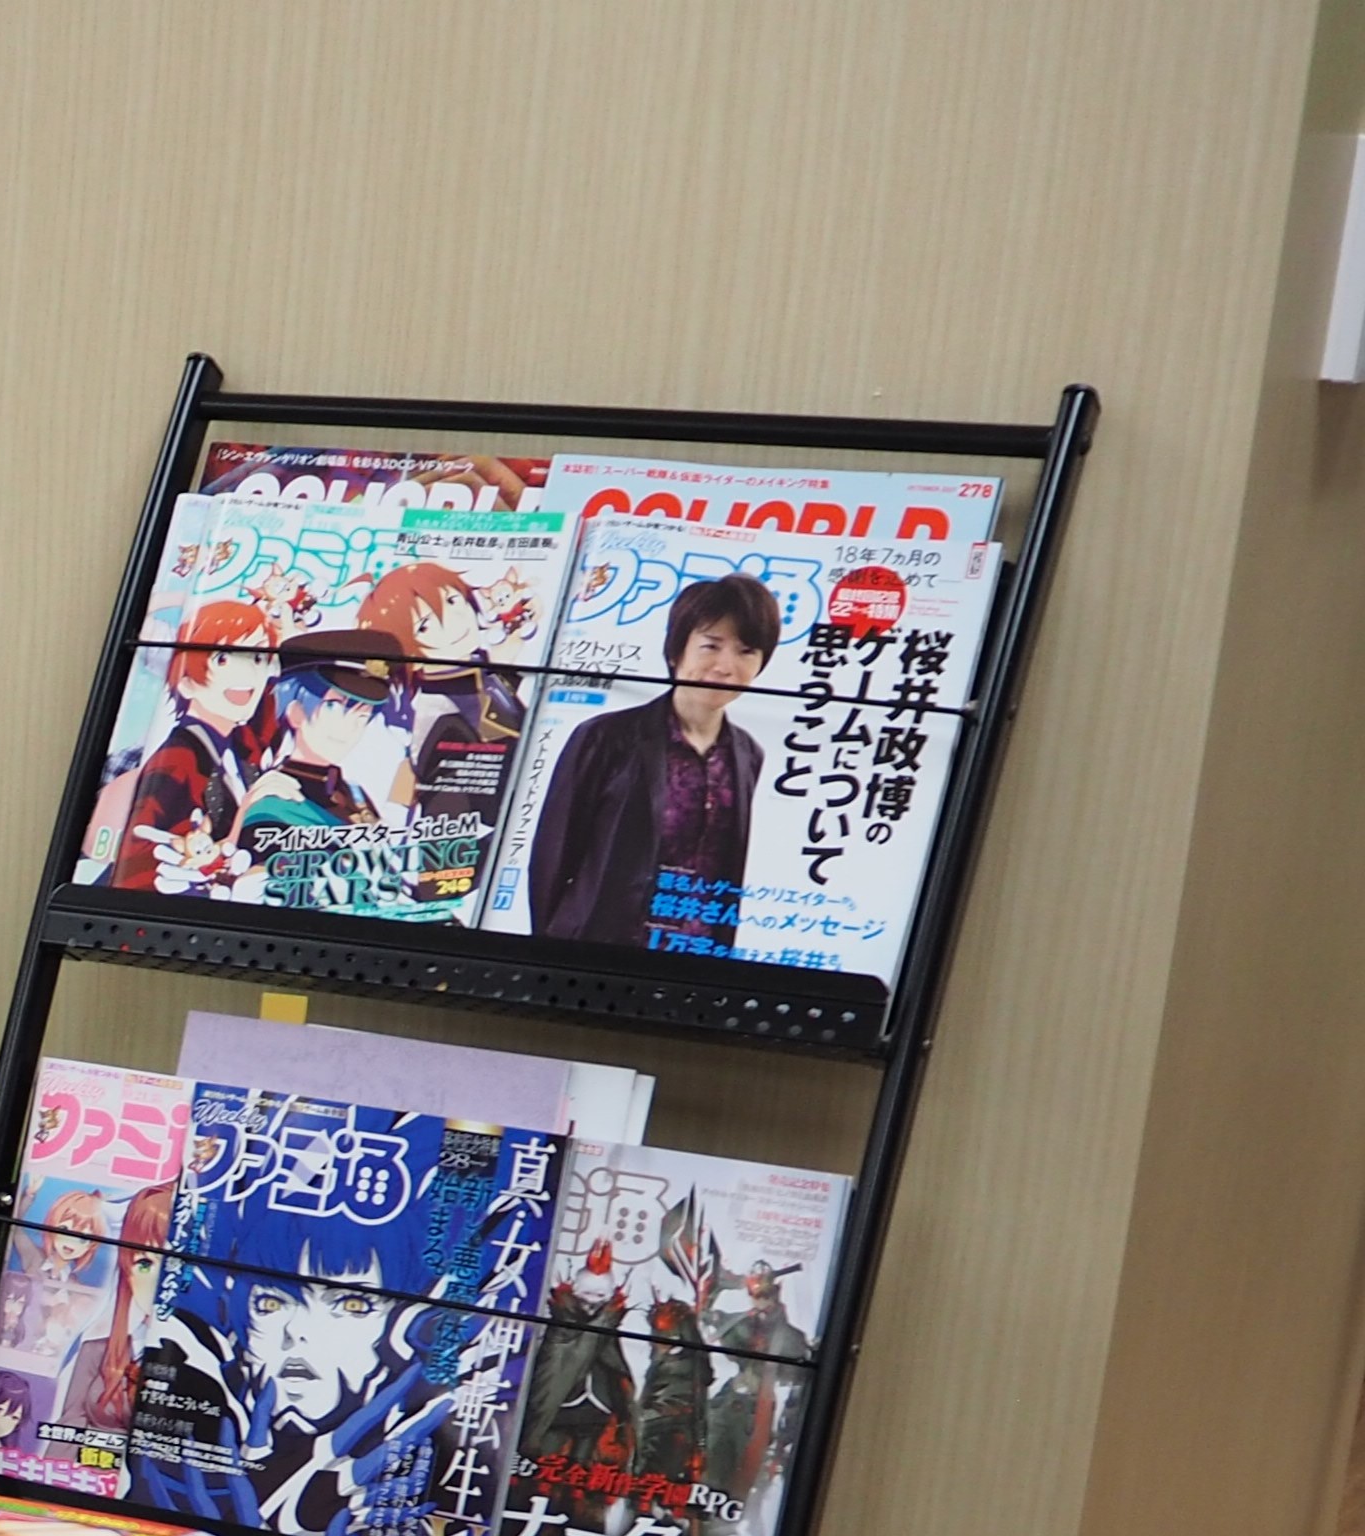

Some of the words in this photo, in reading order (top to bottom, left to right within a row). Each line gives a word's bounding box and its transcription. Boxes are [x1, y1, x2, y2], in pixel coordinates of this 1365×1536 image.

[957, 483, 993, 498] 278
[559, 639, 643, 661] オクトパス
[774, 622, 855, 797] 思うこと
[801, 625, 902, 886] ゲームについて
[862, 629, 956, 845] 桜井政博の
[254, 822, 408, 850] アイドルマスター
[411, 812, 480, 840] SideM
[265, 838, 481, 881] GROWING
[263, 875, 403, 908] STARS
[650, 894, 887, 941] 桜井さんへのメッセージ
[179, 1121, 413, 1227] ファミ通
